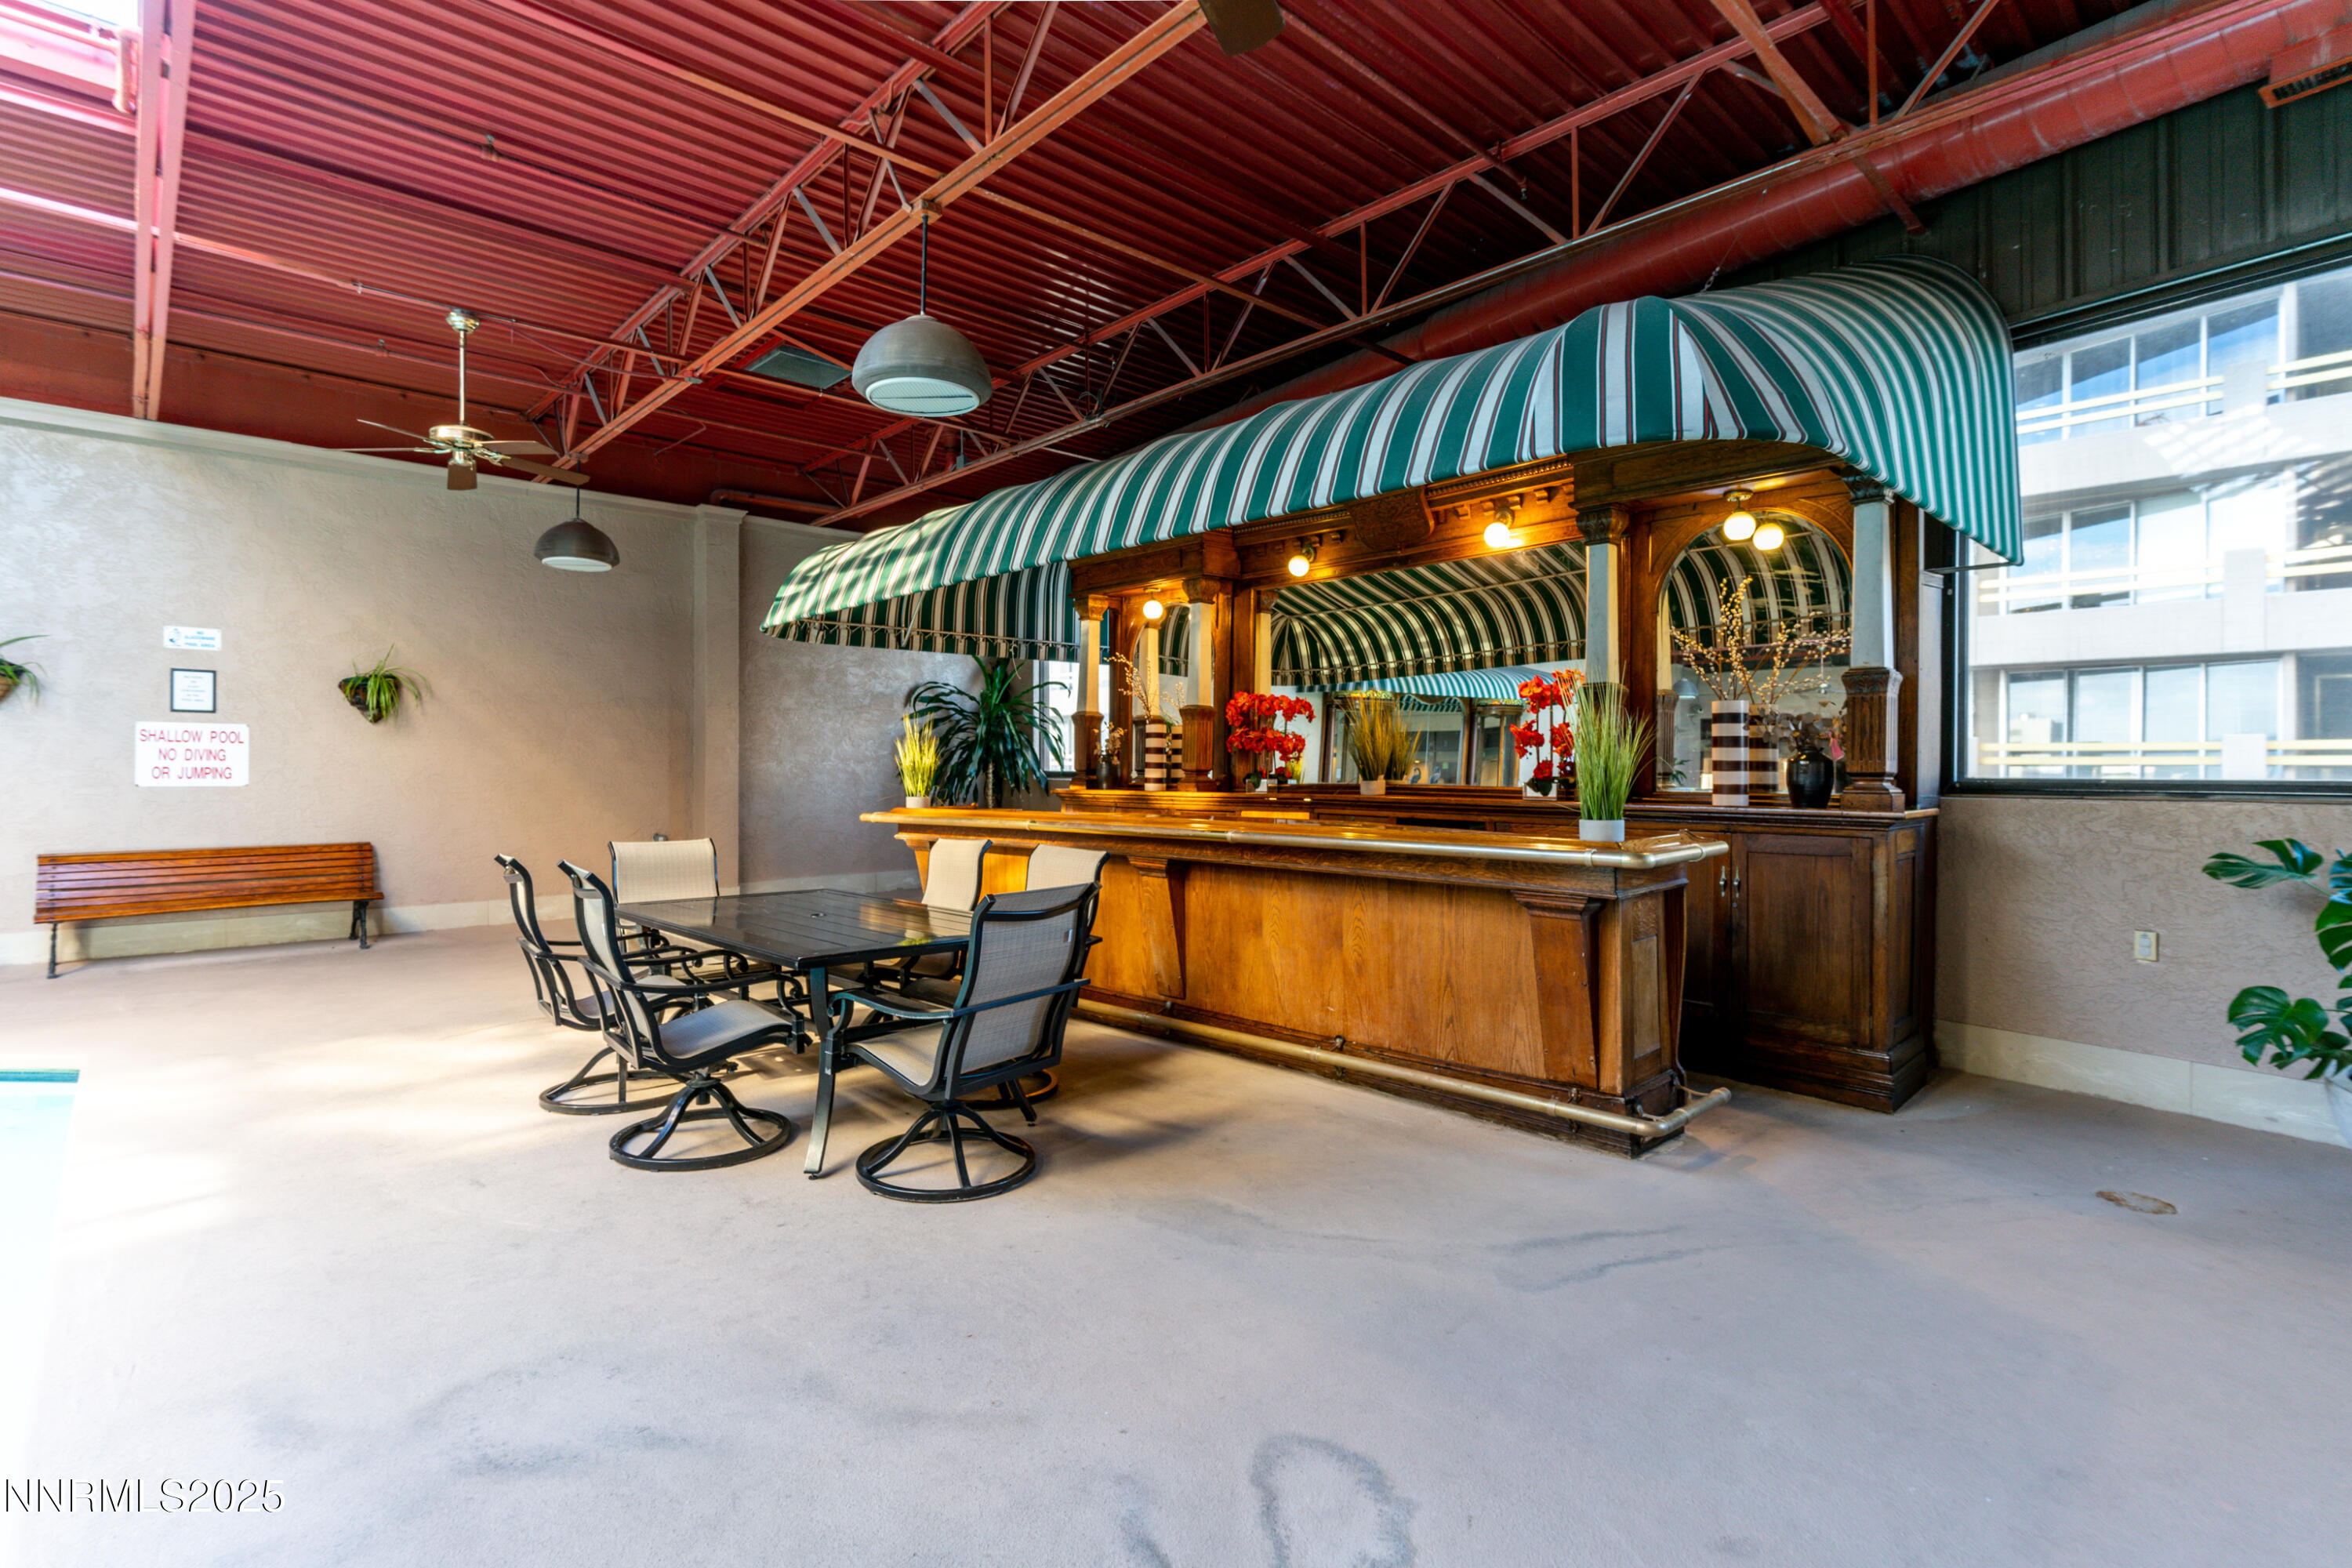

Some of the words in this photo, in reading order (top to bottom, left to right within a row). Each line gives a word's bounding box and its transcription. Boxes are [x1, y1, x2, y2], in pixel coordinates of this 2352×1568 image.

[139, 728, 203, 742] SHALLOW
[210, 730, 245, 744] POOL
[158, 748, 177, 761] NO
[184, 748, 227, 761] DIVING
[151, 766, 170, 779] OR
[177, 766, 233, 779] JUMPING
